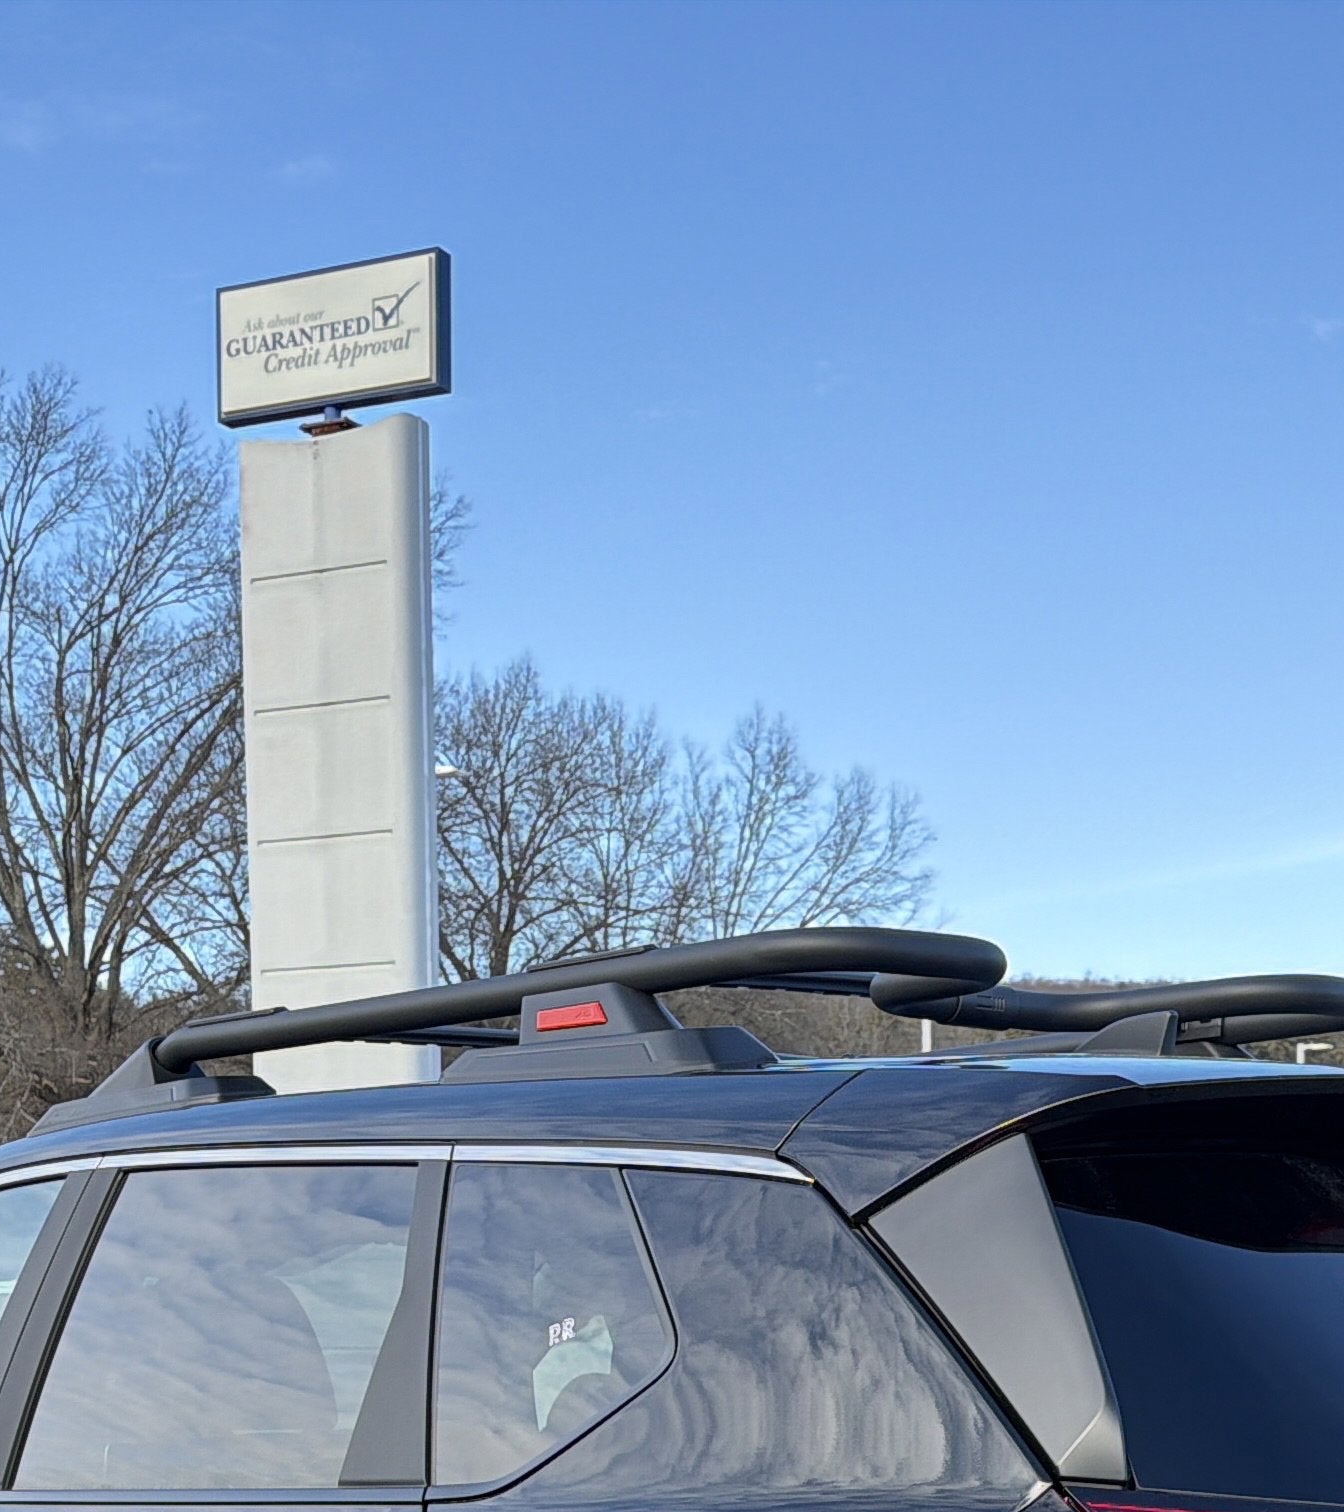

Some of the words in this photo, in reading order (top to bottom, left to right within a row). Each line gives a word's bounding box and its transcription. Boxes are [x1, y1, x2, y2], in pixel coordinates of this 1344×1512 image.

[225, 315, 371, 358] GUARANTEED
[243, 316, 264, 334] Ask
[267, 312, 300, 329] about
[303, 309, 325, 323] our
[263, 346, 321, 374] Credit
[324, 328, 411, 369] Approval
